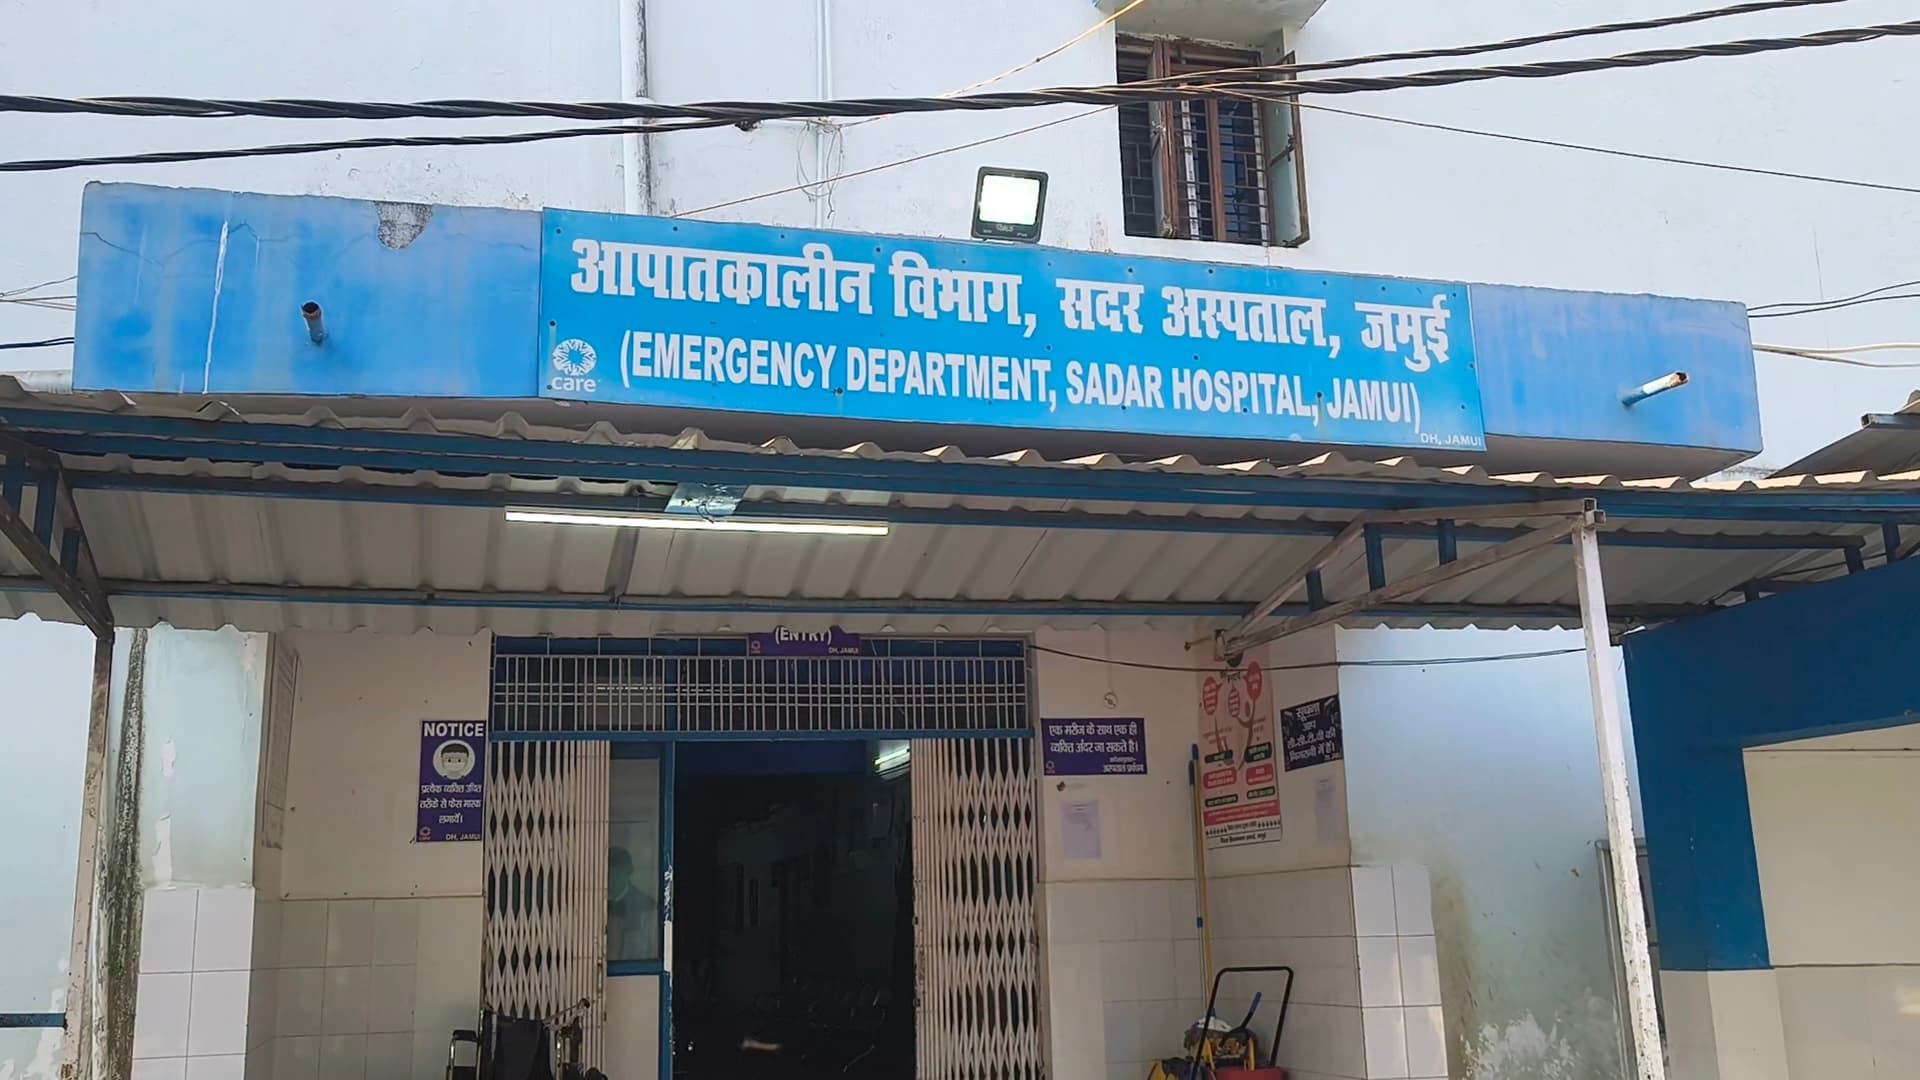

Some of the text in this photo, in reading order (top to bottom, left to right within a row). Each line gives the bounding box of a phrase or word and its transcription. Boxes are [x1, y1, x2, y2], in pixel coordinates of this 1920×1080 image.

[570, 238, 1451, 372] आपातकालीन विभाग, सदर अस्पताल, जमुई
[551, 376, 597, 393] care
[620, 329, 1421, 434] (EMERGENCY DEPARTMENT, SADAR HOSPITAL, JAMUI)
[1445, 434, 1482, 447] JAMUI
[424, 723, 484, 737] NOTICE
[1048, 721, 1137, 737] एक मरीज के साथ एक ही
[1094, 742, 1105, 753] जा
[1105, 739, 1127, 753] सकते
[440, 798, 447, 809] से
